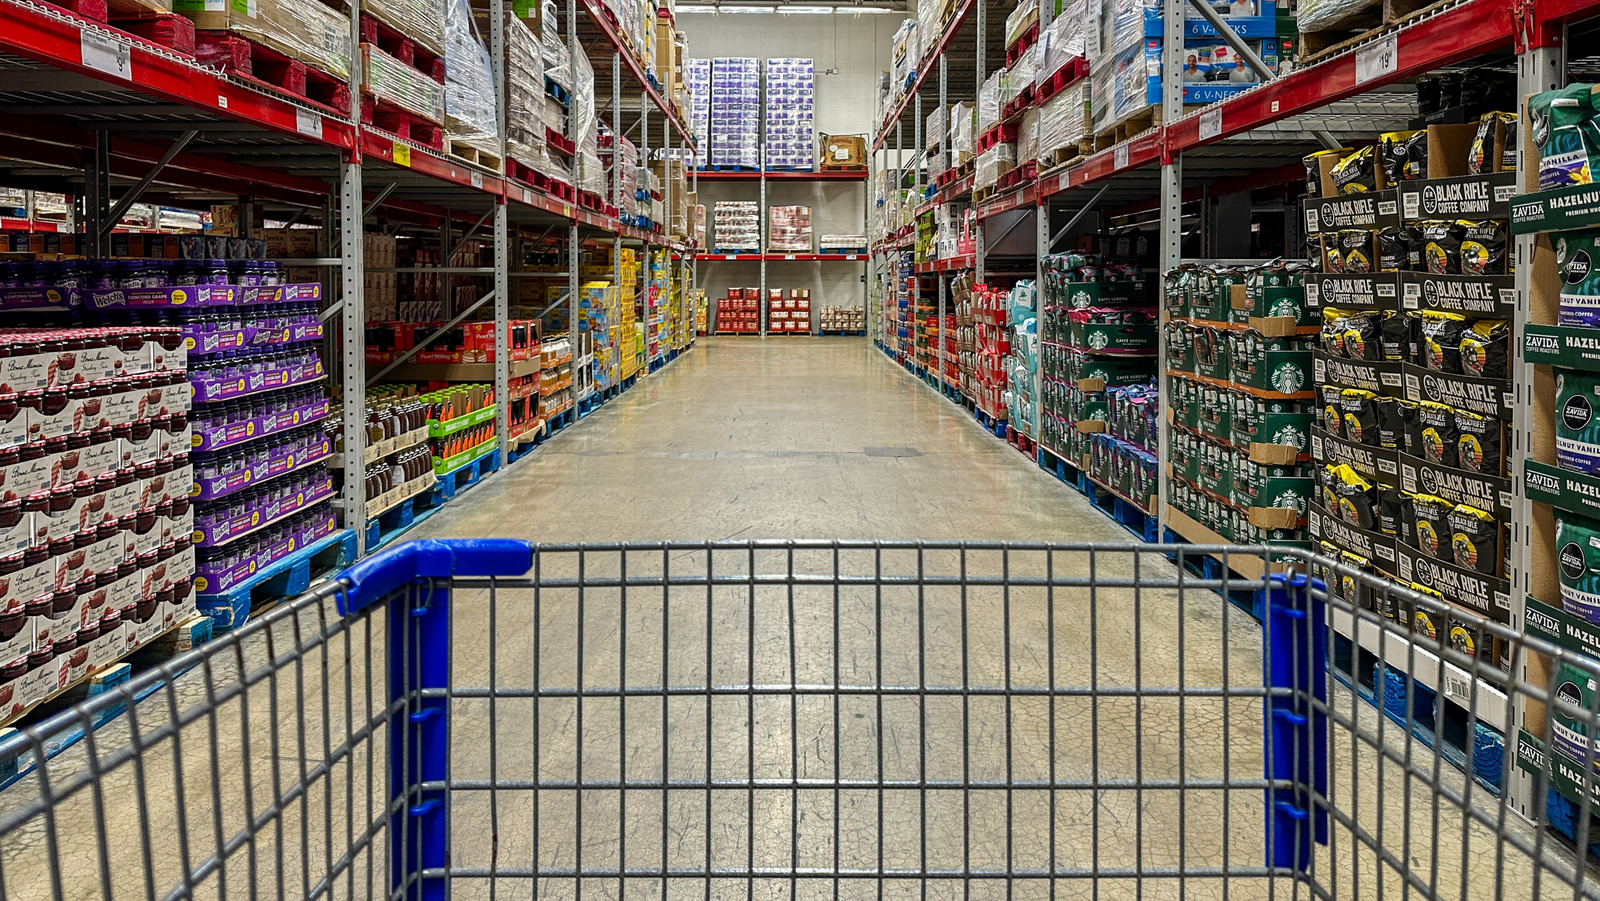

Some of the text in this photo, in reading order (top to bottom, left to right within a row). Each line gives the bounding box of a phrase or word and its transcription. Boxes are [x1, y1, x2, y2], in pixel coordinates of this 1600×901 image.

[1192, 25, 1247, 34] 6 V-CKS
[1194, 91, 1238, 100] 6 V-NEC
[1542, 154, 1580, 168] VANILLA
[1436, 182, 1489, 201] BLACK RIFLE
[1332, 199, 1374, 216] BLACK RIFLE
[1438, 200, 1490, 214] COFFEE COMPANY
[1512, 205, 1544, 218] ZAVIDA
[1566, 208, 1588, 216] PREMIUM
[1336, 214, 1376, 226] COFFEE COMPANY
[1526, 214, 1545, 222] ROASTERS
[1333, 279, 1373, 294] BLACK RIFLE
[1437, 280, 1463, 298] BLACK
[1463, 282, 1493, 300] RIFLE
[96, 291, 123, 307] Welch's
[1336, 293, 1374, 304] COFFEE COMPANY
[1440, 298, 1495, 312] COFFEE COMPANY
[1526, 336, 1559, 348] ZAVIDA
[1337, 362, 1355, 378] BLACK
[1356, 366, 1377, 381] RIFLE
[1340, 376, 1380, 391] COFFEE COMPANY
[1437, 378, 1466, 398] BLACK
[1467, 384, 1496, 402] RIFLE
[1442, 394, 1465, 409] COFFEE
[1467, 400, 1498, 415] COMPANY
[1566, 407, 1587, 417] ZAVIDA
[1334, 439, 1374, 465] BLACK RIFLE
[1353, 462, 1376, 476] COMPANY
[1436, 471, 1493, 499] BLACK RIFLE
[1527, 472, 1560, 490] ZAVIDA
[1527, 482, 1540, 490] COFFEE
[1439, 487, 1494, 512] COFFEE COMPANY
[1332, 520, 1371, 546] BLACK RIFLE
[1335, 535, 1350, 548] COFFEE
[1350, 543, 1373, 560] COMPANY
[1431, 564, 1489, 599] BLACK RIFLE
[1435, 580, 1457, 600] COFFEE
[1458, 589, 1489, 611] COMPANY
[1526, 610, 1560, 633] ZAVIDA
[1526, 620, 1539, 630] COFFEE
[1560, 764, 1600, 798] HAZLN
